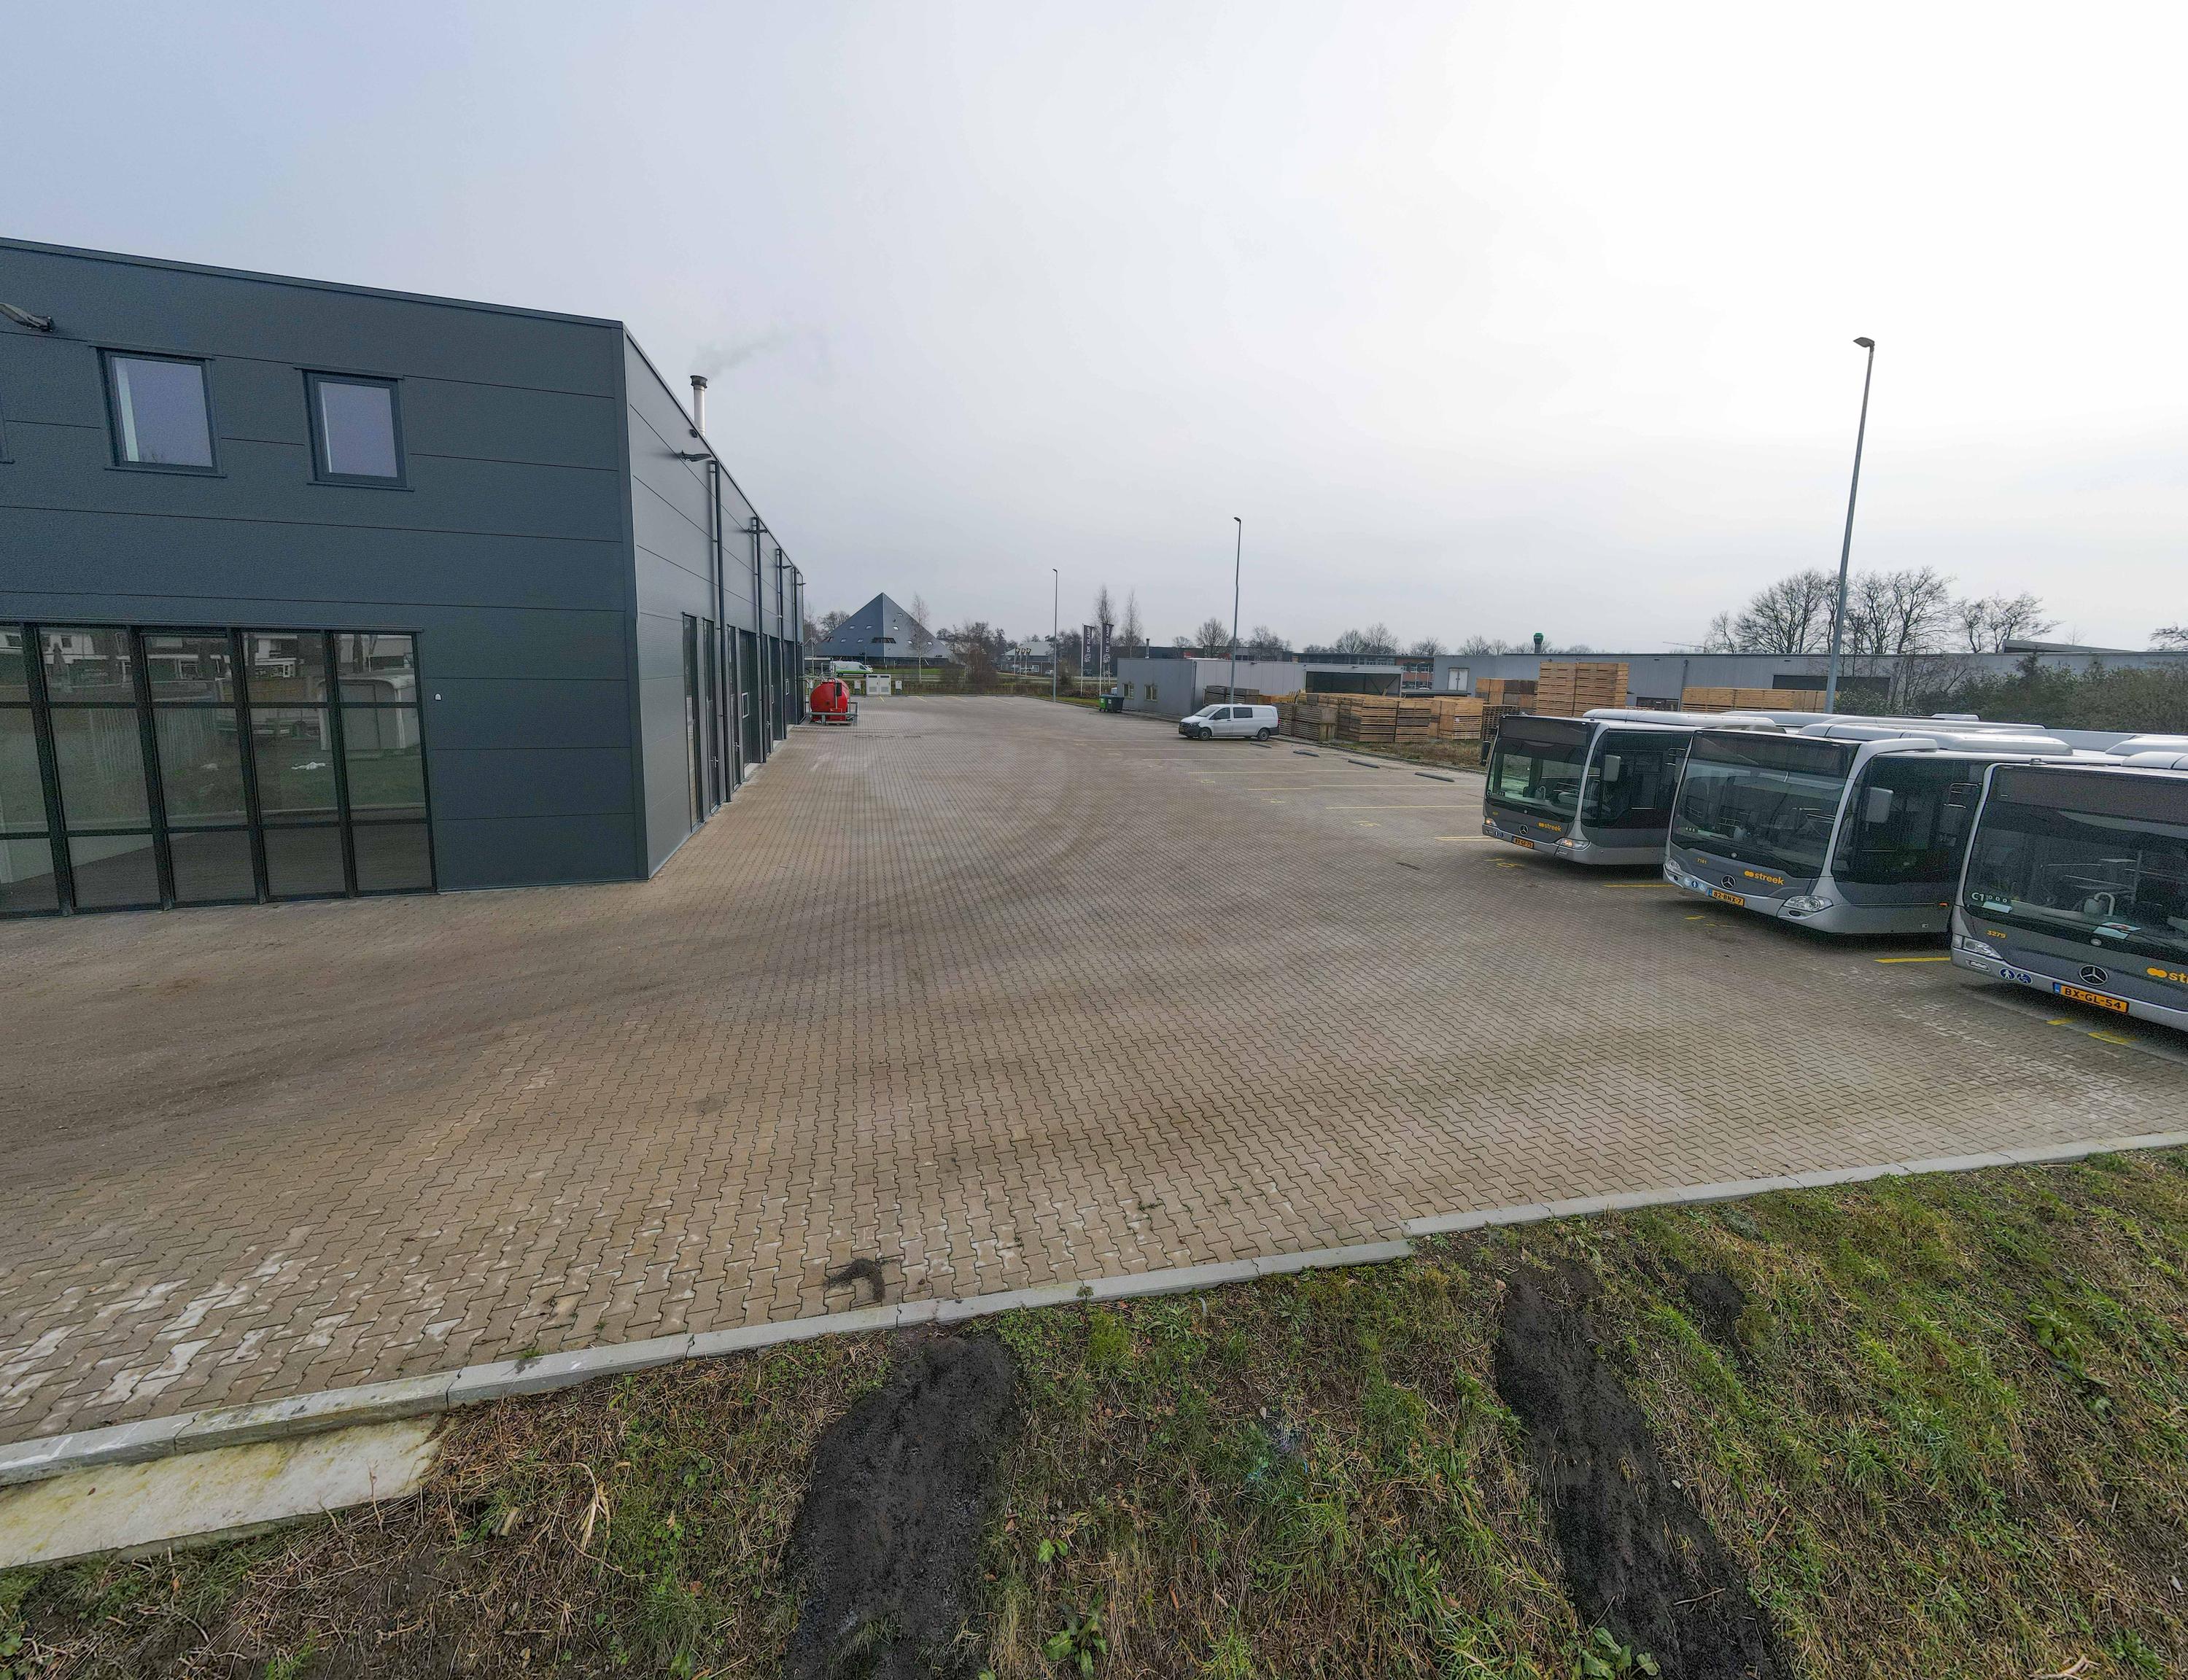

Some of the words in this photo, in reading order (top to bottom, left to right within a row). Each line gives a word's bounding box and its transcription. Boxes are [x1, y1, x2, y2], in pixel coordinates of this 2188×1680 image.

[1712, 890, 1742, 904] 82-BNX-7
[1986, 930, 2007, 939] 3279
[2064, 987, 2122, 1010] BX-GL-54
